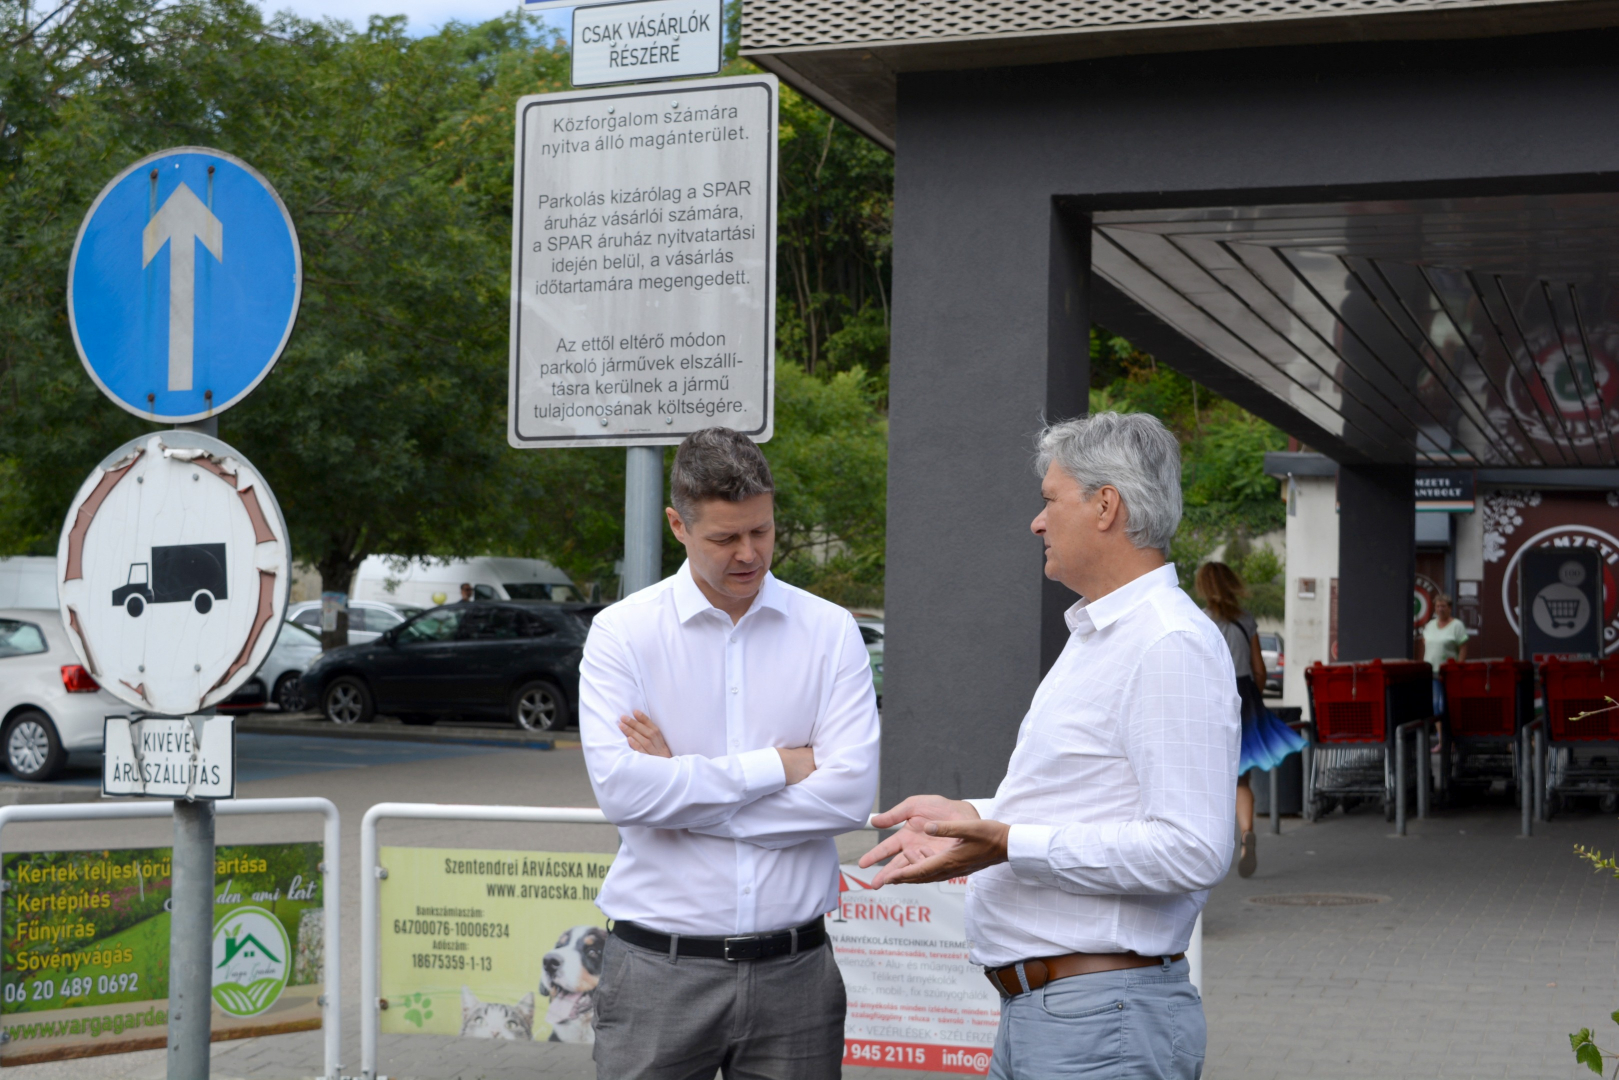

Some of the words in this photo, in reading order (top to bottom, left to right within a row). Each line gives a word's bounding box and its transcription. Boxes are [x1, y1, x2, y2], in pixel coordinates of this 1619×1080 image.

[582, 23, 623, 44] CSAK
[628, 10, 710, 39] VÁSÁRLÓK
[609, 42, 680, 68] RÉSZÉRE
[553, 111, 658, 133] Közforgalom
[663, 105, 738, 124] számára
[541, 137, 590, 158] nyitva
[595, 134, 624, 151] álló
[629, 125, 749, 149] magánterület.
[538, 191, 605, 209] Parkolás
[610, 185, 682, 204] kizárólag
[687, 187, 697, 199] a
[702, 180, 752, 198] SPAR
[544, 212, 597, 231] áruház
[602, 207, 663, 227] vásárlói
[668, 204, 743, 223] számára,
[532, 240, 542, 252] a
[547, 234, 593, 252] SPAR
[598, 230, 652, 249] áruház
[657, 225, 755, 248] nyitvatartási
[551, 256, 597, 276] idején
[603, 253, 645, 271] belül,
[650, 254, 660, 267] a
[666, 248, 734, 266] vásárlás
[535, 276, 633, 296] időtartamára
[638, 270, 750, 291] megengedett.
[556, 337, 577, 353] Az
[581, 335, 615, 352] ettől
[619, 333, 665, 350] eltérő
[670, 331, 726, 348] módon
[540, 357, 597, 378] parkoló
[601, 354, 675, 376] járművek
[680, 352, 743, 370] elszállí-
[551, 380, 590, 396] tásra
[595, 376, 662, 395] kerülnek
[668, 379, 678, 392] a
[682, 375, 730, 395] jármű
[534, 399, 652, 421] tulajdonosának
[657, 398, 748, 417] költségére.
[1415, 478, 1450, 487] MZETI
[143, 726, 191, 752] KIVÉVE
[113, 757, 220, 786] ÁRUSZÁLLÍTÁS
[17, 863, 79, 883] Kertek
[84, 857, 171, 884] teljeskörű
[445, 857, 518, 876] Szentendrei
[522, 856, 583, 879] ÁRVÁCSKA
[17, 887, 111, 914] Kertépítés
[252, 887, 281, 903] ami
[286, 874, 317, 900] kert
[486, 882, 599, 901] www.arvacska.hu
[416, 905, 485, 919] Bankszámlaszám:
[827, 898, 931, 927] ERINGER
[17, 917, 96, 944] Fűnyírás
[394, 919, 510, 939] 64700076-10006234
[840, 934, 937, 949] ÁRNYÉKOLÁSTECHNIKAI
[939, 939, 969, 950] TERMÉ
[16, 942, 133, 972] Sövényvágás
[432, 938, 469, 951] Adószám:
[412, 953, 493, 972] 18675359-1-13
[920, 960, 964, 975] műanyag
[4, 982, 27, 1003] 06
[32, 979, 54, 1001] 20
[60, 976, 93, 998] 489
[97, 972, 139, 995] 0692
[871, 971, 905, 983] Télikert
[906, 973, 958, 988] árnyékolók
[923, 987, 989, 1003] szúnyoghálók
[866, 1025, 932, 1039] VEZÉRLÉSEK
[851, 1043, 881, 1061] 945
[885, 1045, 926, 1064] 2115
[942, 1048, 992, 1072] info@
